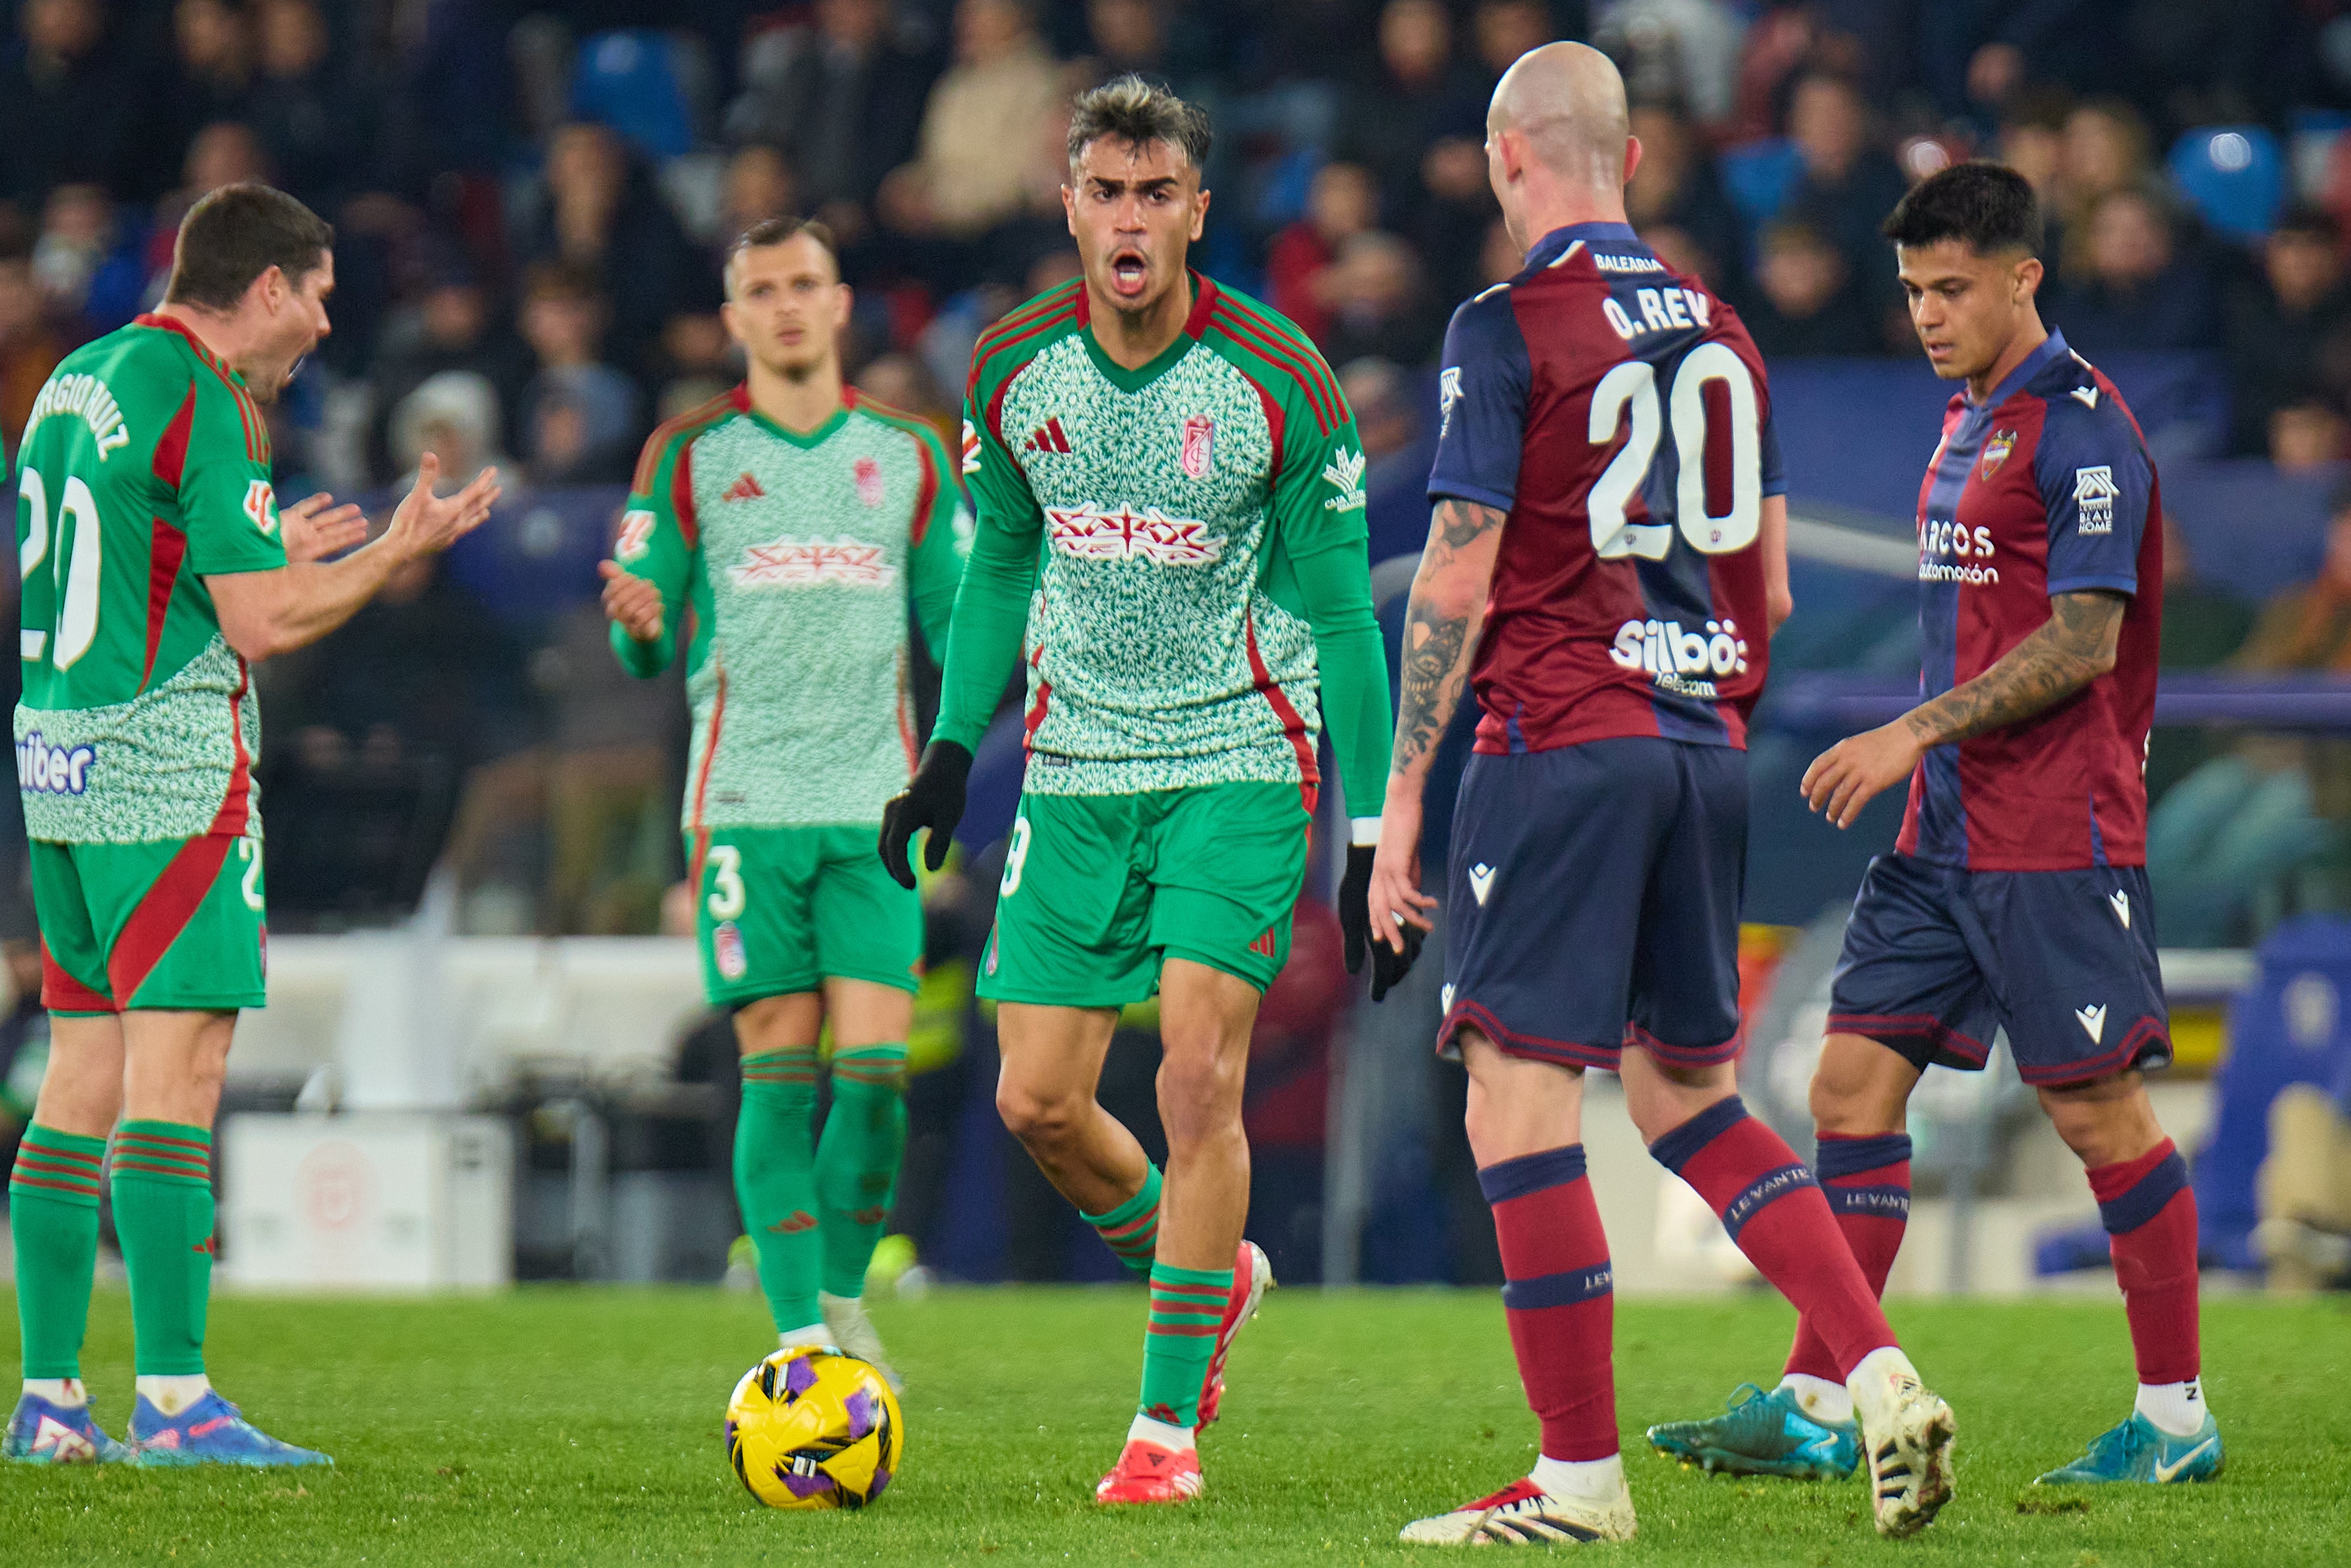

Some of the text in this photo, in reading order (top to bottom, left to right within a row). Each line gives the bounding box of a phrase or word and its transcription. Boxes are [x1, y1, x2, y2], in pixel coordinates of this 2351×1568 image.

[1588, 343, 1762, 561] 20
[2078, 520, 2112, 535] HOME
[2079, 510, 2112, 523] BLAU
[19, 466, 102, 672] 20
[708, 845, 745, 920] 3
